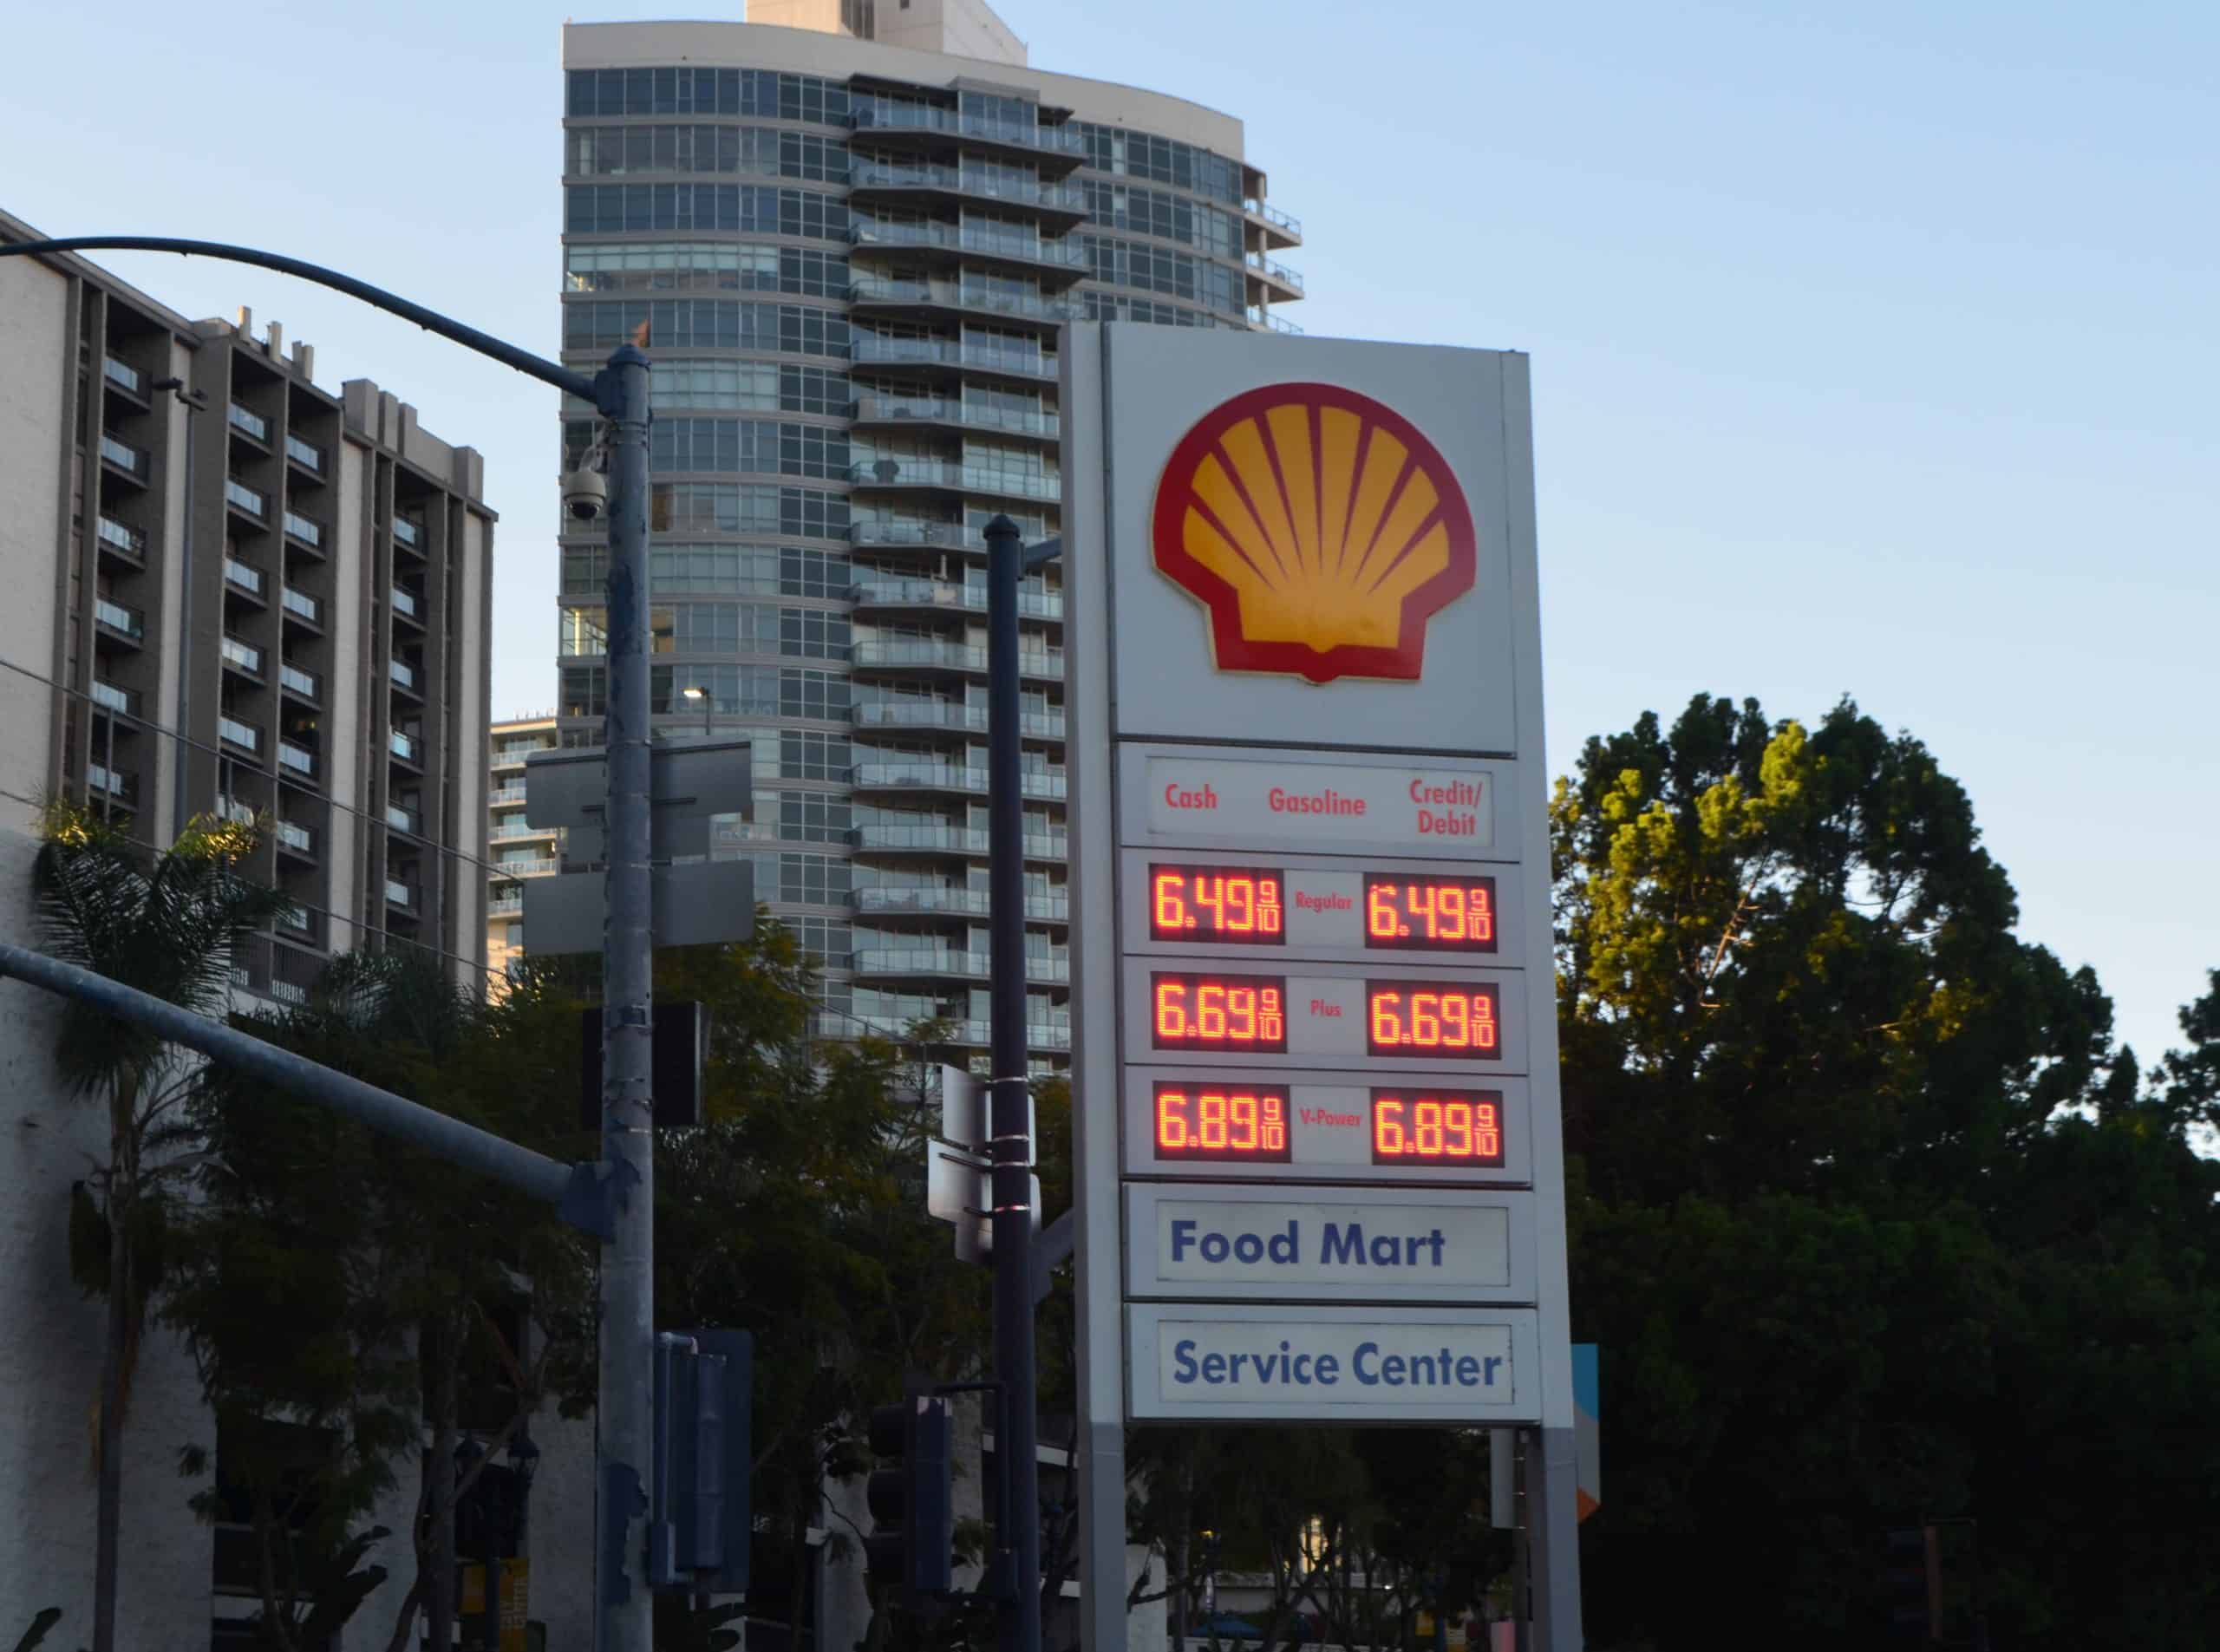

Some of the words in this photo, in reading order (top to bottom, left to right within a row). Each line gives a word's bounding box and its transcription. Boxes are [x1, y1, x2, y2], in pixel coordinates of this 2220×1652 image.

[1166, 783, 1218, 810] Cash
[1269, 787, 1367, 816] Gasoline
[1409, 779, 1483, 808] Credit/
[1417, 809, 1476, 836] Debit
[1156, 875, 1254, 931] 6.49
[1296, 891, 1353, 913] Regular
[1370, 885, 1466, 939] 6.49
[1157, 983, 1257, 1040] 6.69
[1310, 999, 1342, 1017] Plus
[1372, 994, 1471, 1046] 6.69
[1159, 1094, 1257, 1149] 6.89
[1300, 1108, 1362, 1127] V-Power
[1375, 1100, 1472, 1155] 6.89
[1172, 1220, 1299, 1263] Food
[1321, 1223, 1446, 1266] Mart
[1173, 1340, 1340, 1385] Service
[1352, 1342, 1503, 1388] Center
